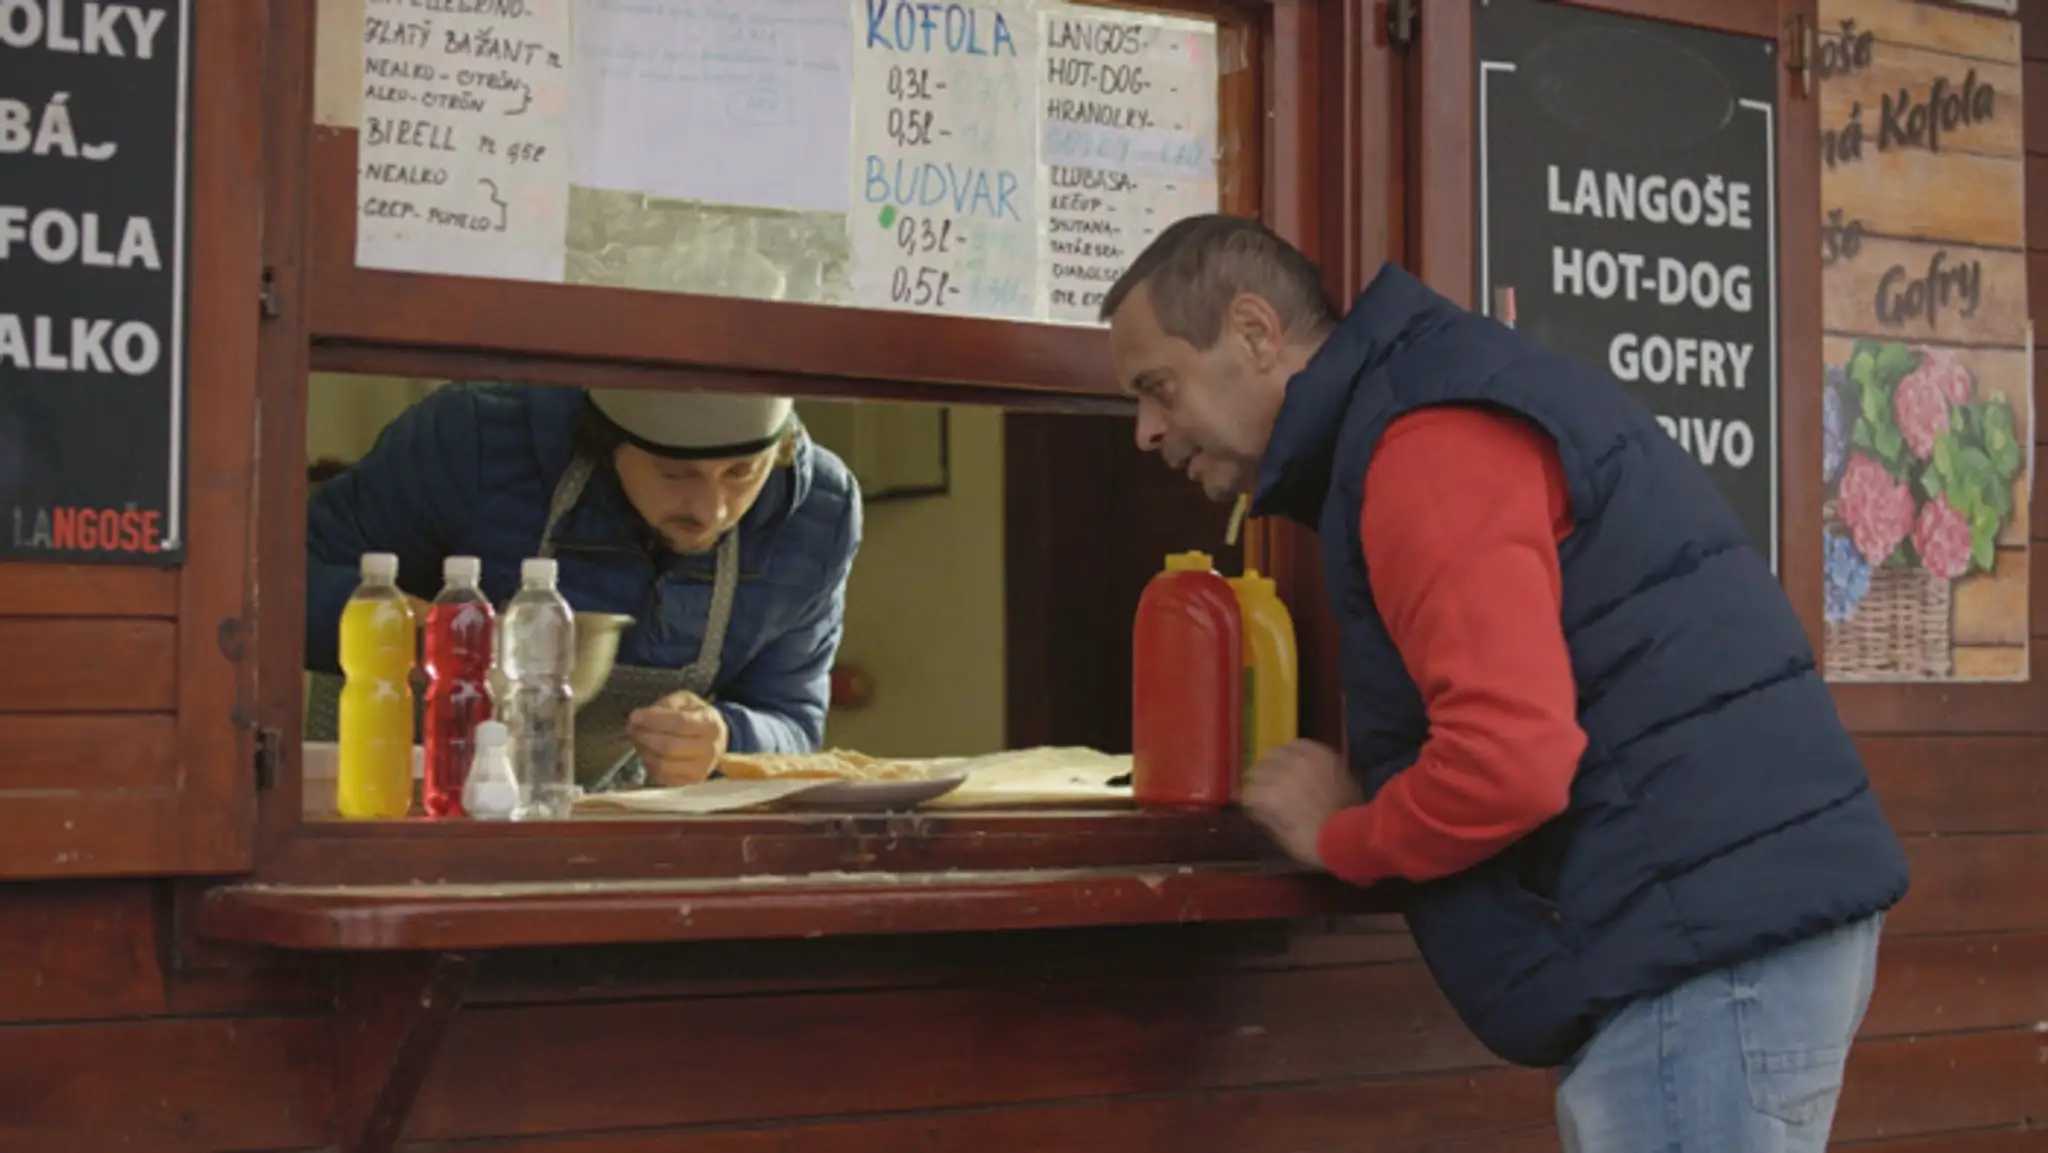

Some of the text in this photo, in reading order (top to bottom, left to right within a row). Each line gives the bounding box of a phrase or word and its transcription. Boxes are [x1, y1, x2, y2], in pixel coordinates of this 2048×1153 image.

[866, 0, 1016, 56] KOFOLA
[0, 91, 118, 161] BÁ
[1878, 67, 1995, 153] Kofola
[865, 154, 1020, 222] BUDVAR
[1546, 164, 1752, 229] LANGOŠE
[1552, 246, 1753, 312] HOT-DOG
[1875, 250, 1982, 330] Gofry
[0, 312, 162, 377] ALKO
[1608, 333, 1754, 390] GOFRY
